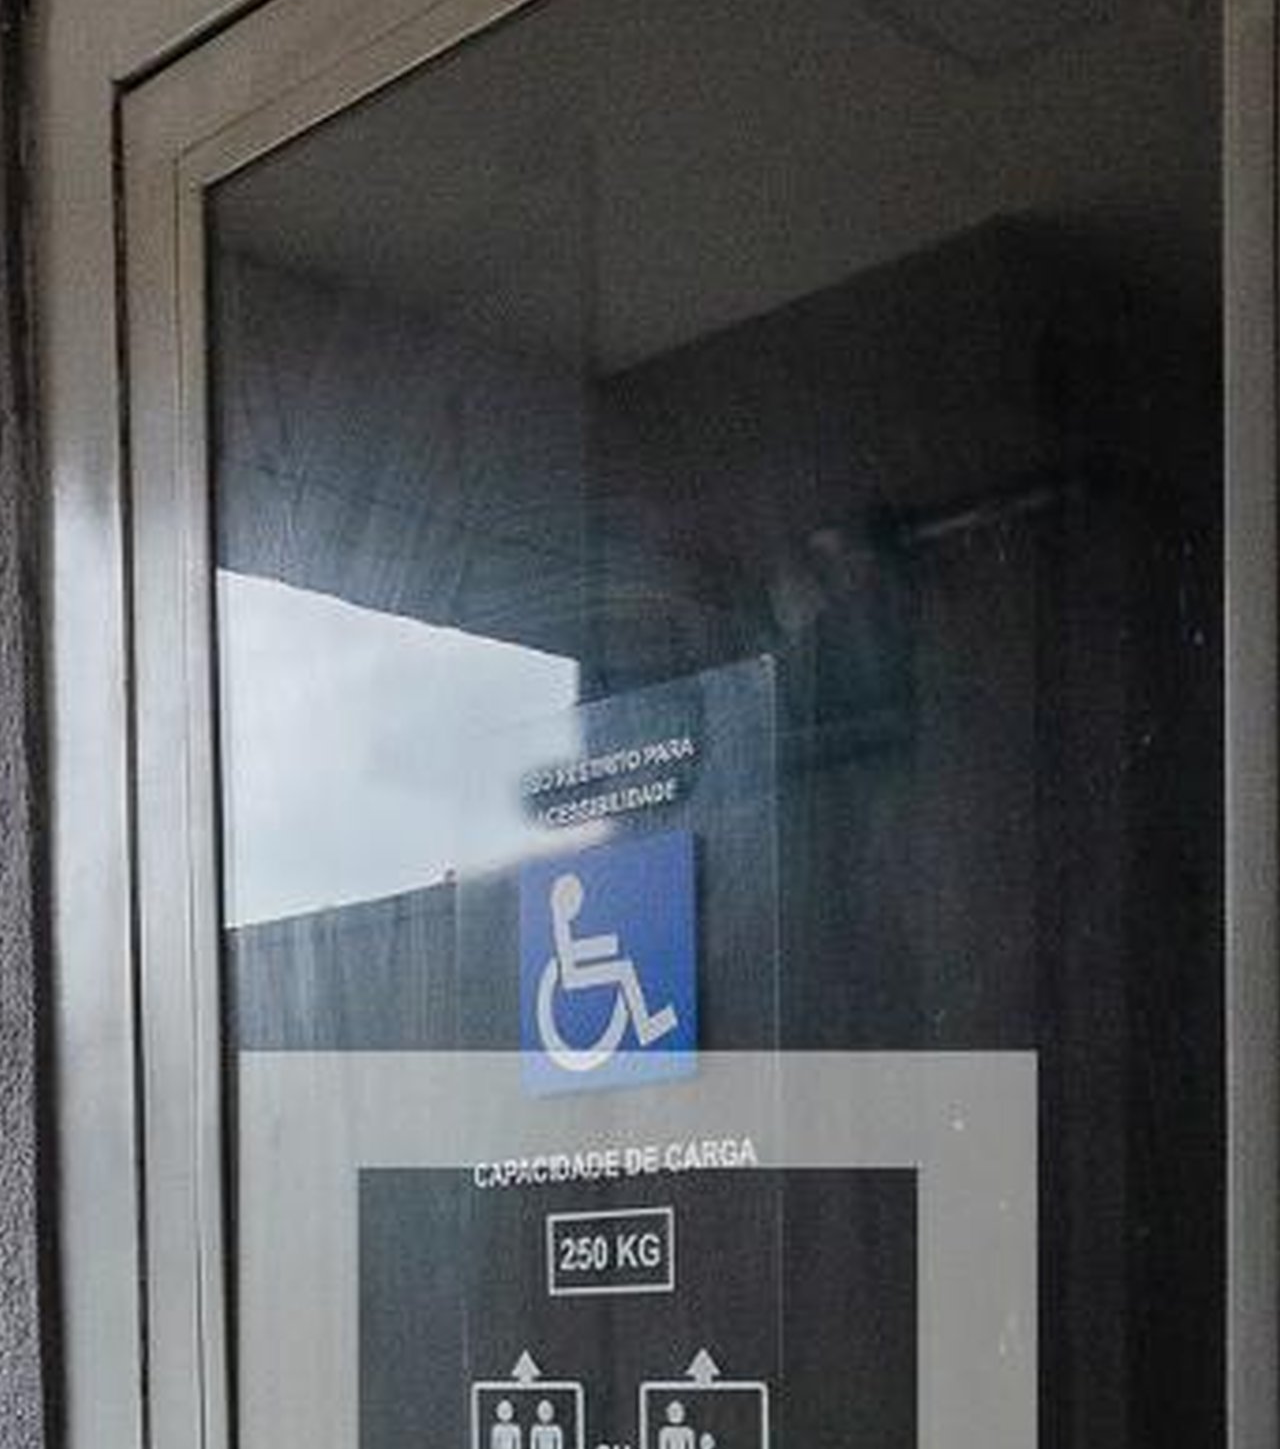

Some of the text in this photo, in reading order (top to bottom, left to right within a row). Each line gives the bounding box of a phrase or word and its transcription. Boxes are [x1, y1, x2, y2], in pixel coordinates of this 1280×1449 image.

[643, 737, 695, 766] PARA
[473, 1138, 758, 1188] CAPACIDADE DE CARGA
[560, 1234, 661, 1271] 250 KG
